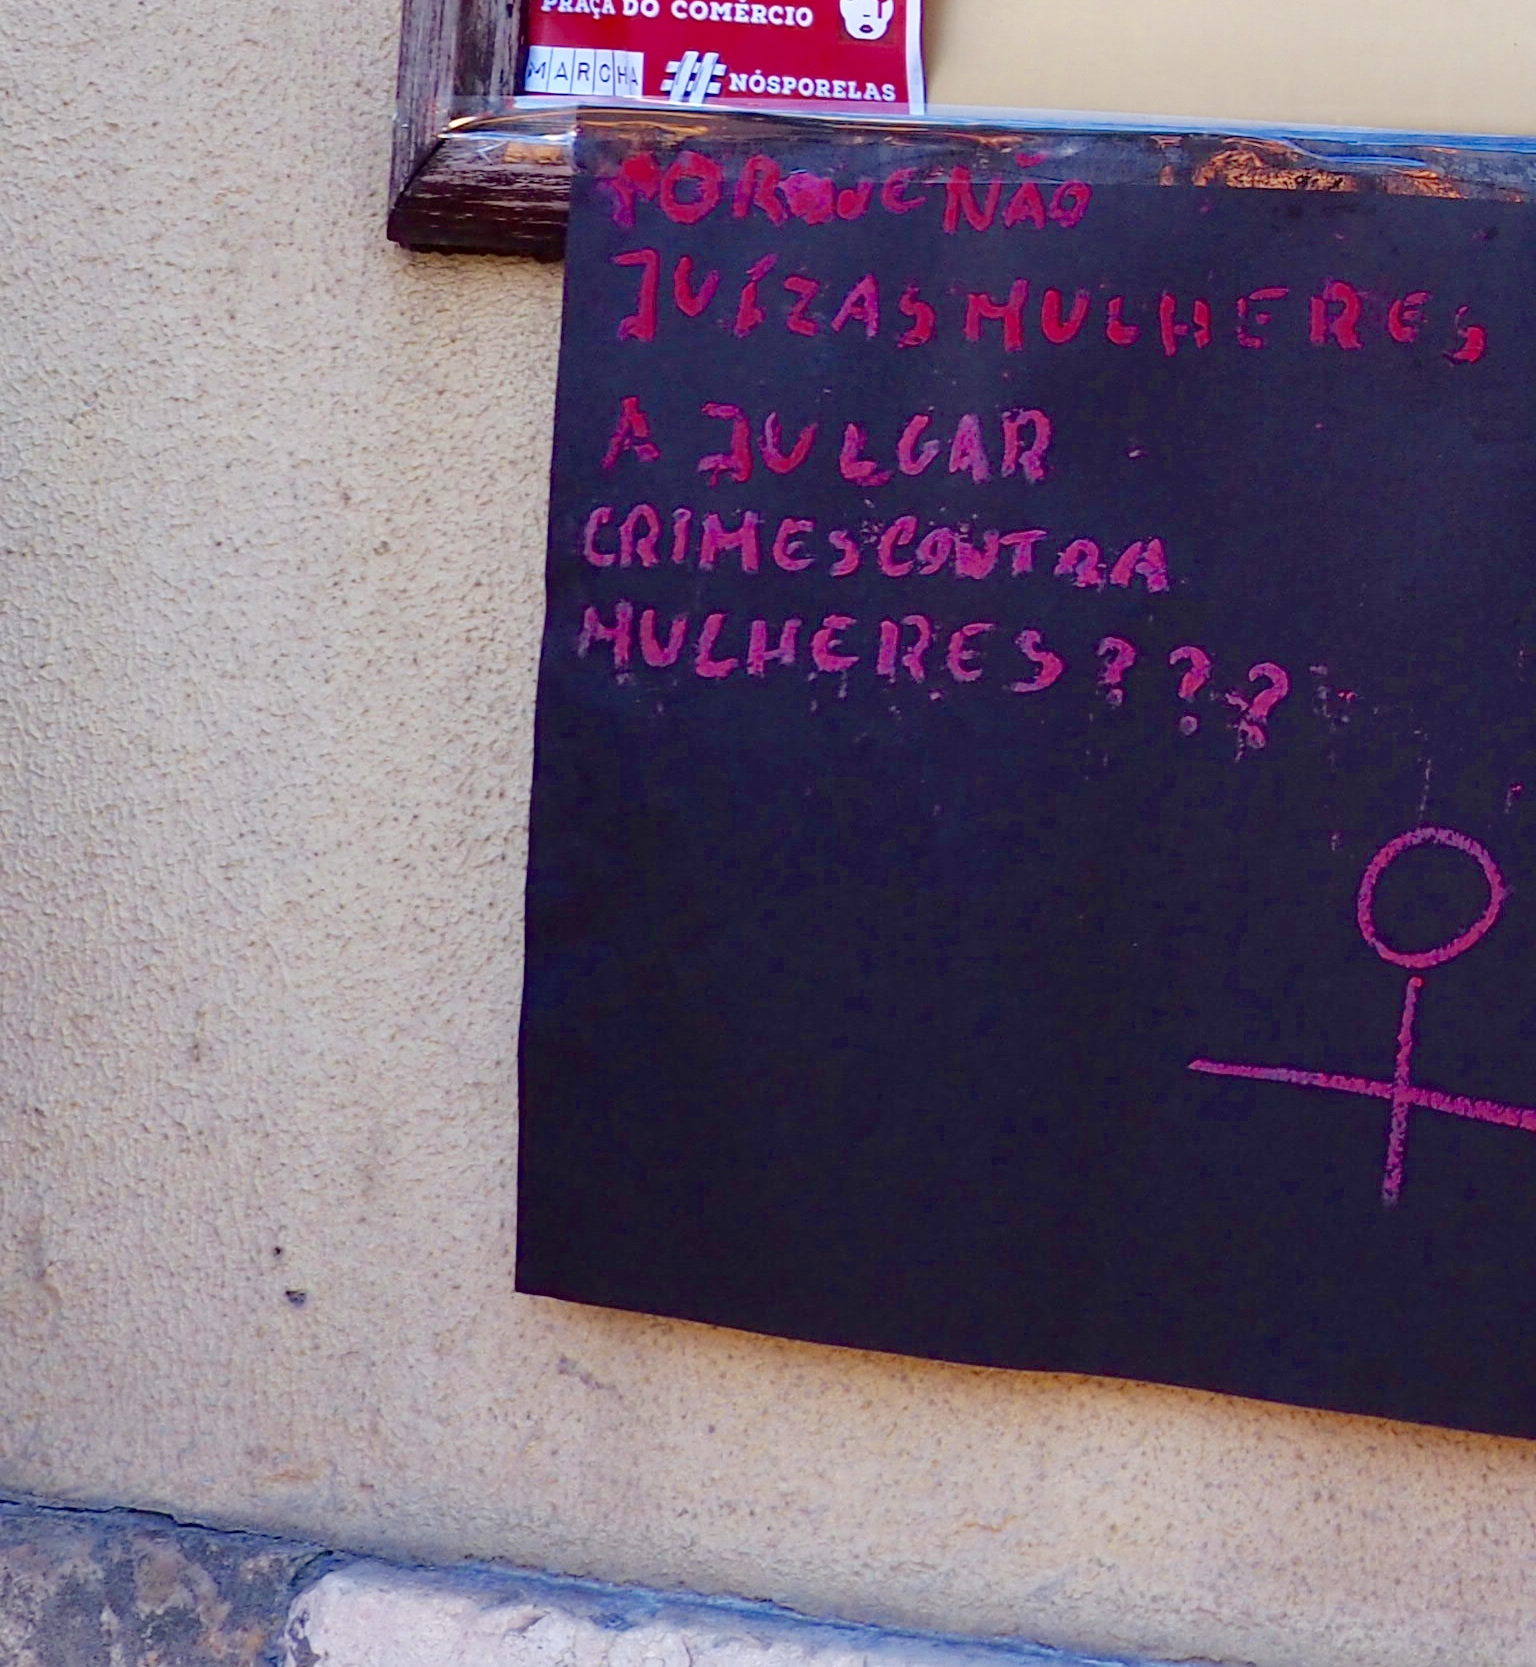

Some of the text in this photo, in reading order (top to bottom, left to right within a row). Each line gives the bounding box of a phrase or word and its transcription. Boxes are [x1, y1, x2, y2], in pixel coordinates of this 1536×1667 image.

[526, 59, 639, 87] MARCHA
[600, 396, 1053, 486] A JULGAR
